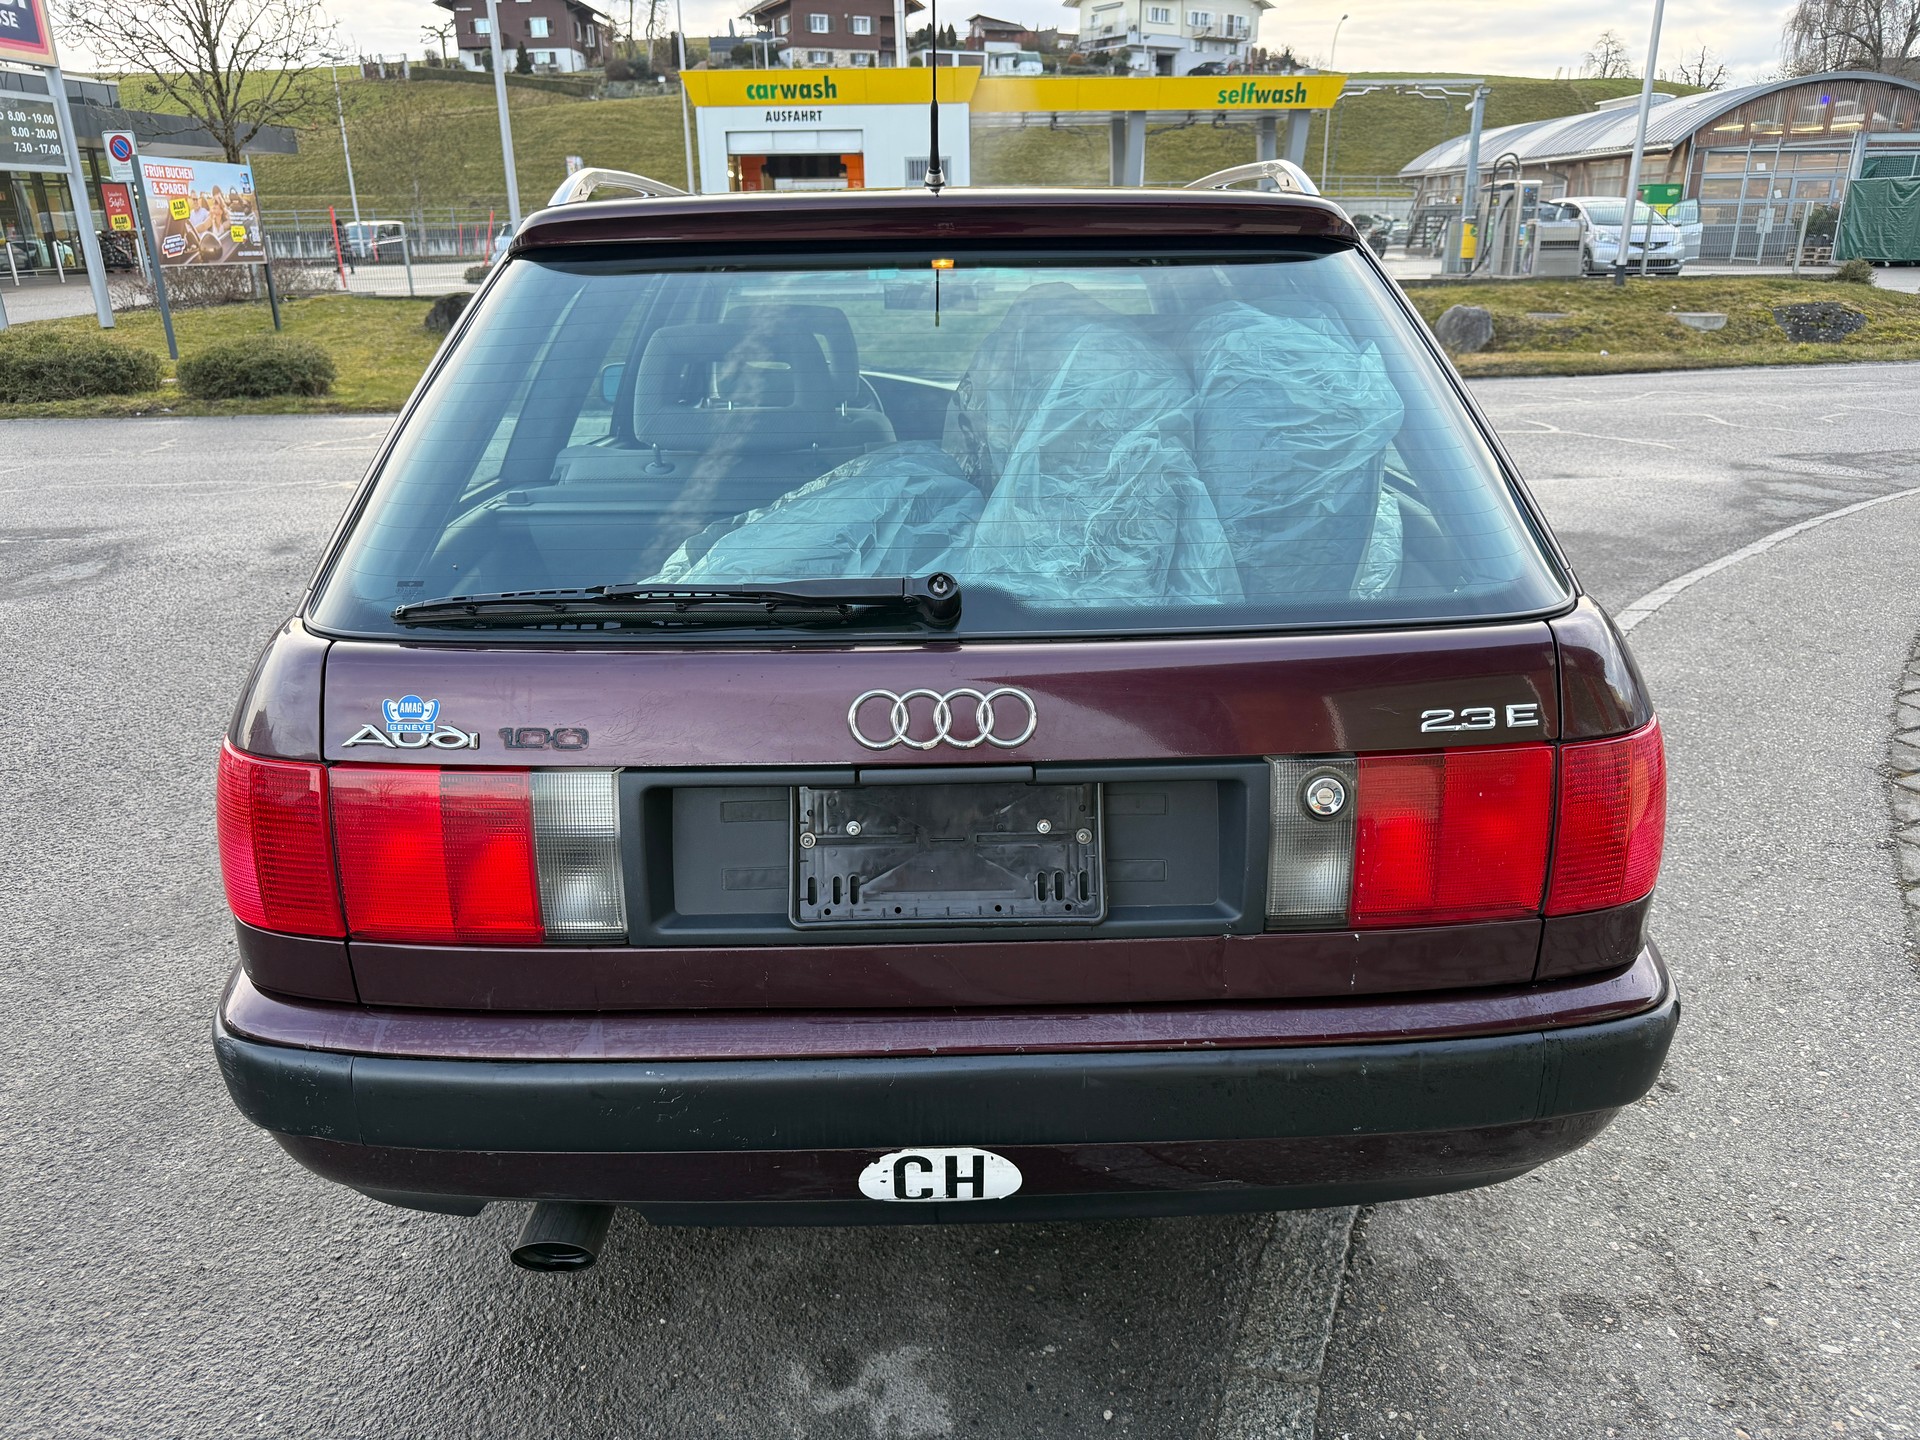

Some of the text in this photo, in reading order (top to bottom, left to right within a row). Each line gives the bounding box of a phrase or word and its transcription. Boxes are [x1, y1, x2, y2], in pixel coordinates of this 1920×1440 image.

[0, 9, 20, 28] SE
[746, 75, 837, 100] carwash
[1217, 81, 1307, 104] selfwash
[7, 110, 26, 122] 8.00
[32, 113, 54, 125] 19.00
[765, 110, 823, 122] AUSFAHRT
[11, 126, 30, 138] 8.00
[35, 128, 58, 140] 20.00
[13, 141, 33, 153] 7.30
[39, 144, 61, 155] 17.00
[165, 167, 194, 180] BUCHEN
[160, 182, 188, 195] SPAREN
[400, 702, 422, 713] AMAG
[1505, 703, 1539, 728] E
[498, 726, 590, 750] 100
[893, 1154, 985, 1199] CH
